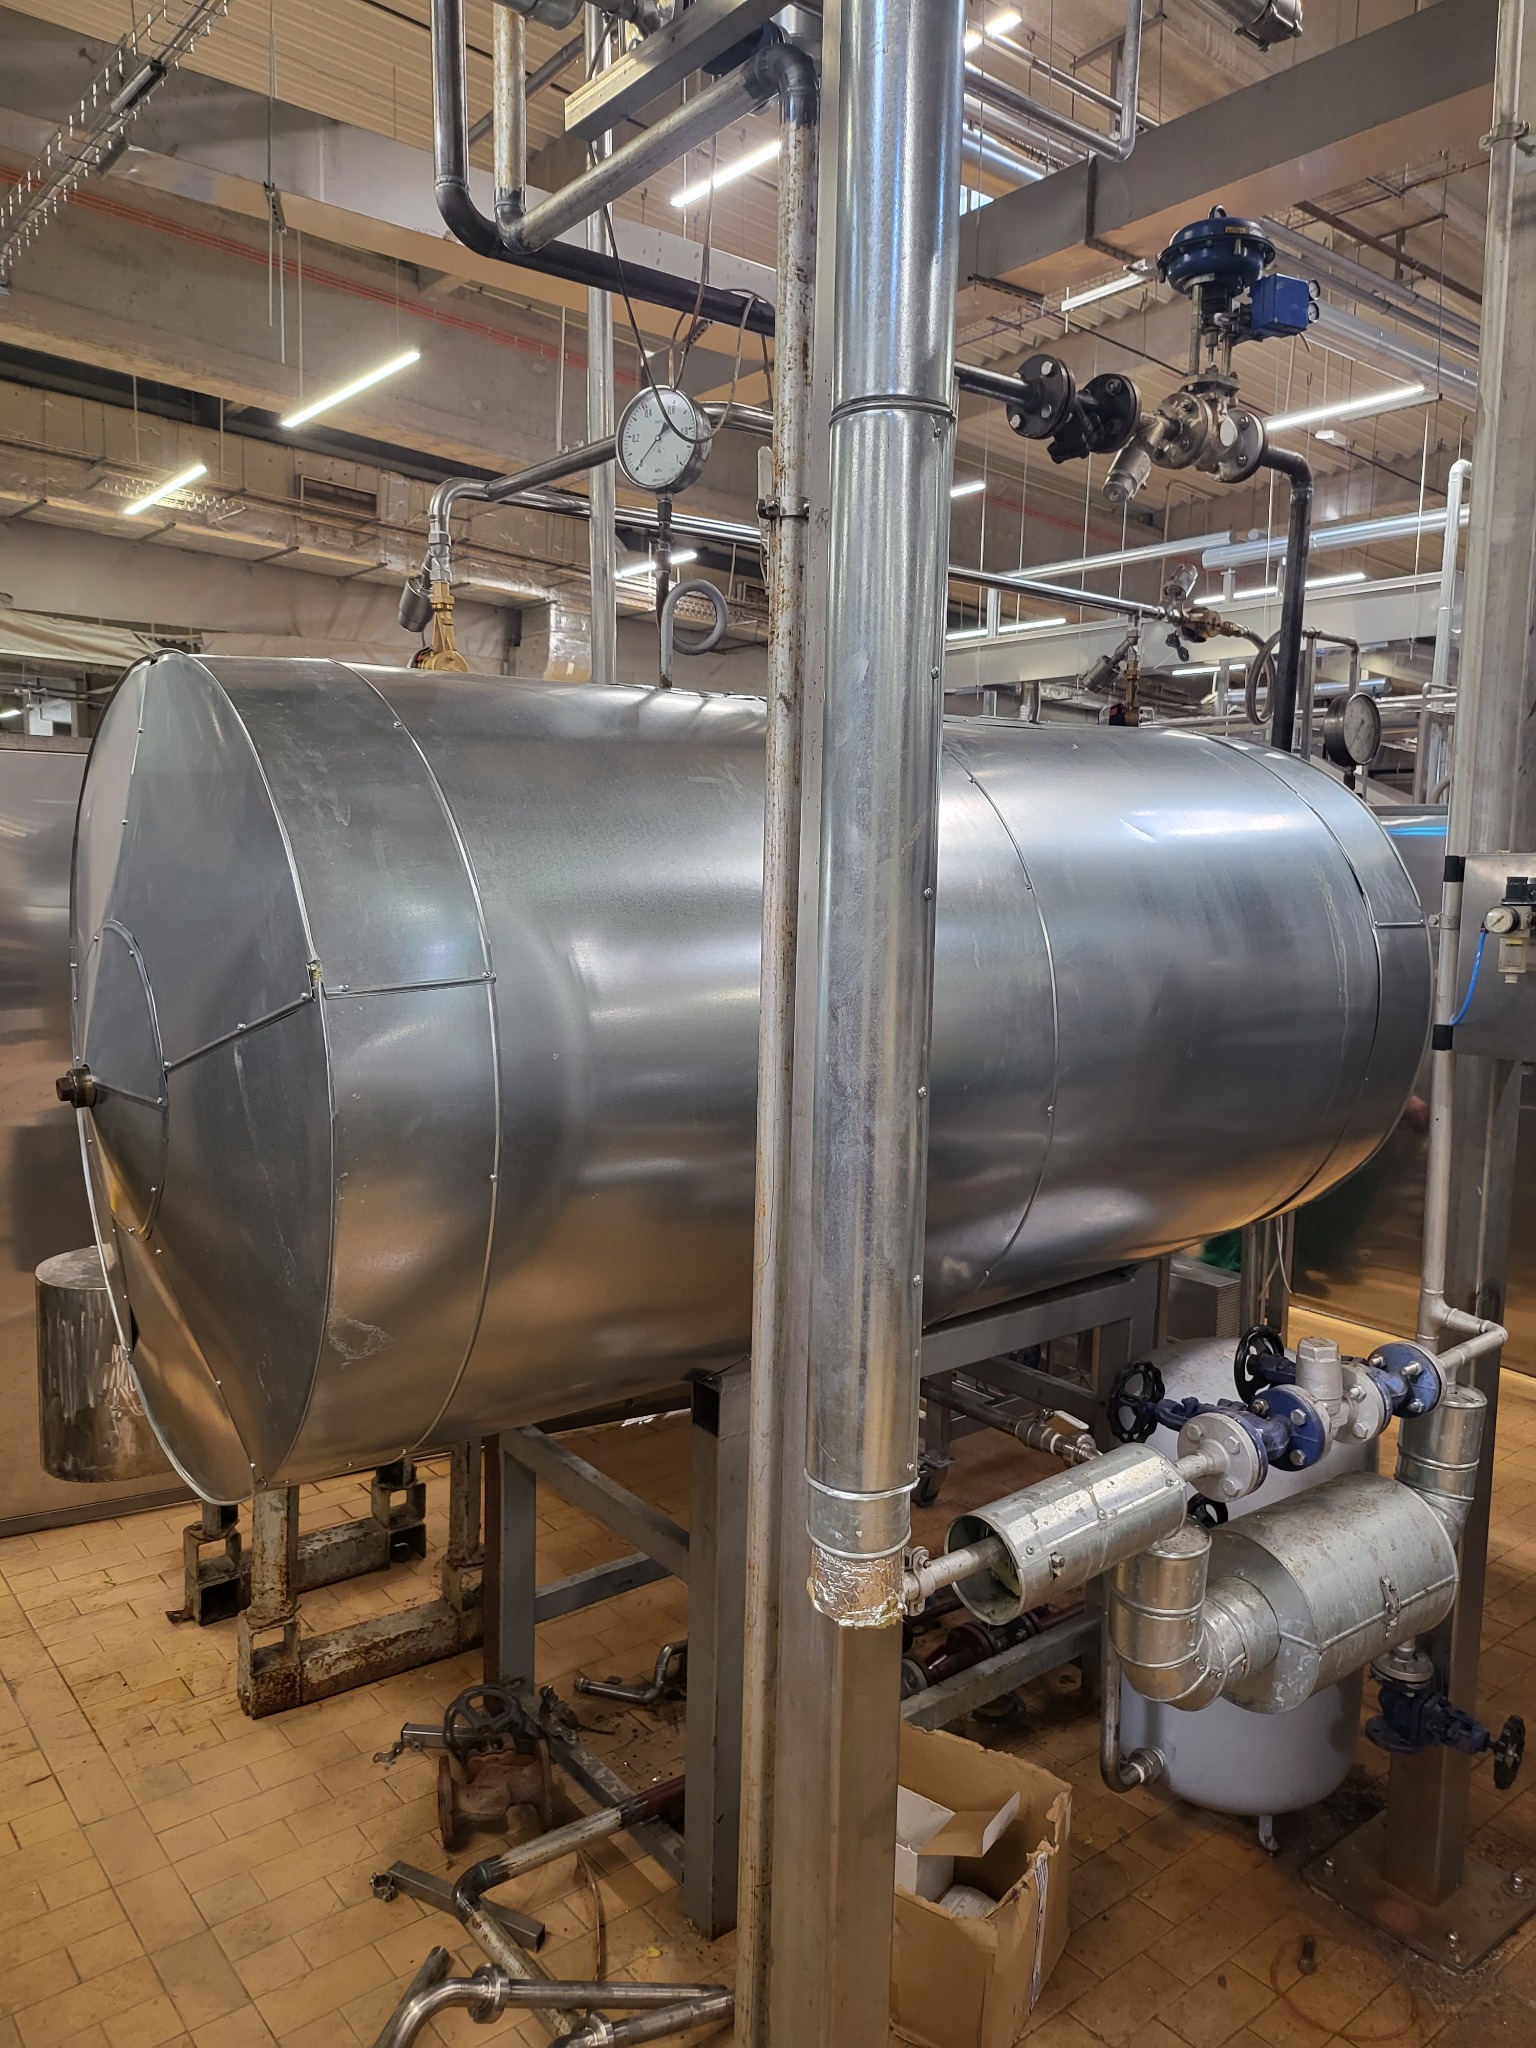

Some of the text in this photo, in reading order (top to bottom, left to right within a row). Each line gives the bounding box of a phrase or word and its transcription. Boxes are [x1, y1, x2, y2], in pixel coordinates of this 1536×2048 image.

[644, 409, 652, 418] 0,4
[680, 426, 688, 436] 08
[632, 433, 640, 443] 0,2
